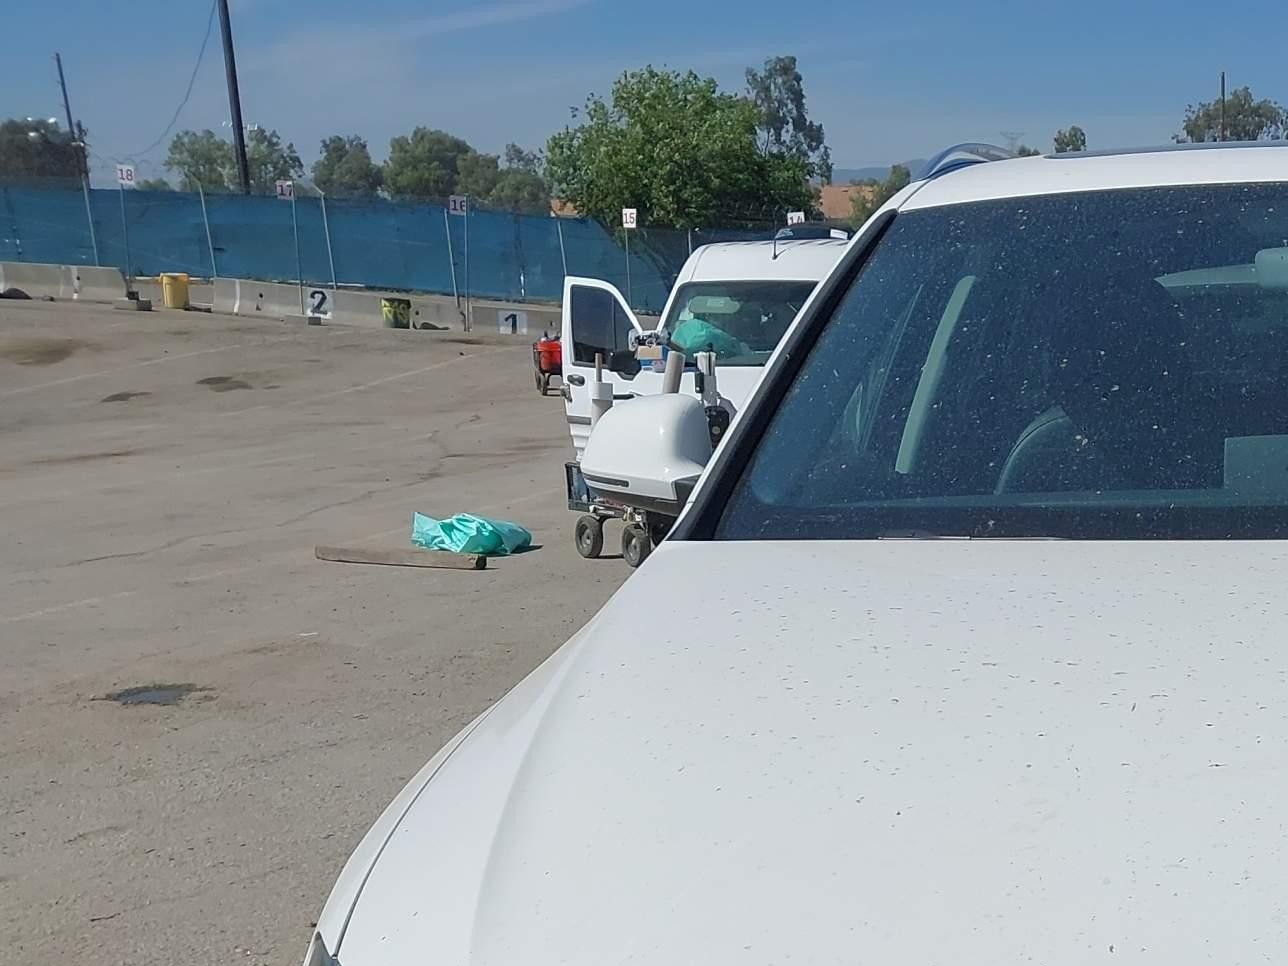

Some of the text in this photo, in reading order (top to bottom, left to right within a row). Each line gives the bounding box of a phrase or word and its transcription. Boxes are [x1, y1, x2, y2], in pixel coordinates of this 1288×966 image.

[118, 168, 133, 181] 18
[278, 184, 293, 197] 17
[451, 199, 466, 212] 16
[623, 212, 635, 225] 15
[310, 290, 328, 315] 2
[504, 313, 518, 334] 1
